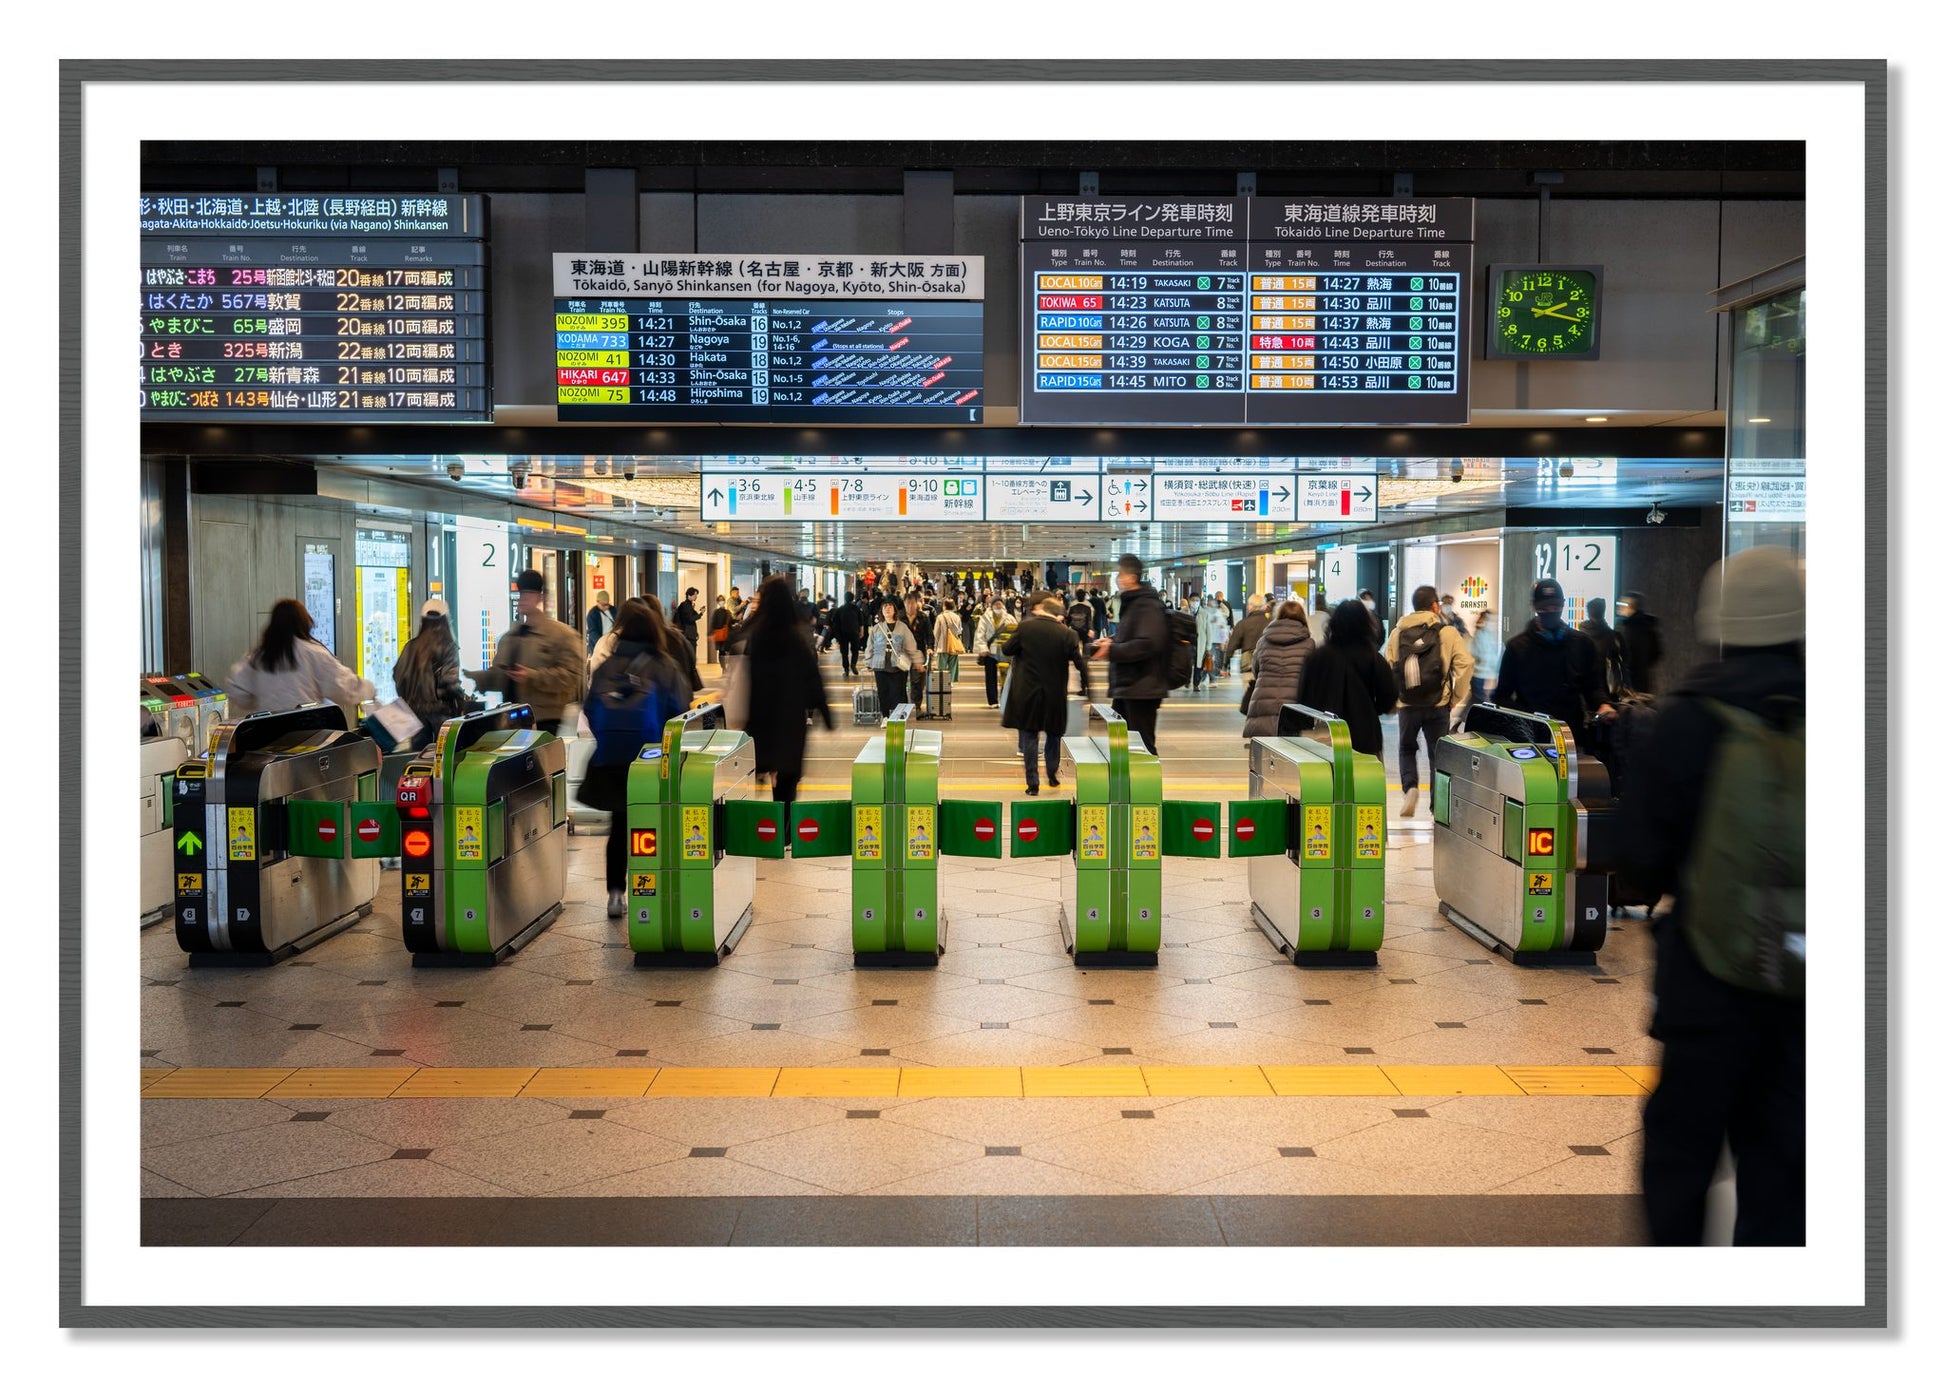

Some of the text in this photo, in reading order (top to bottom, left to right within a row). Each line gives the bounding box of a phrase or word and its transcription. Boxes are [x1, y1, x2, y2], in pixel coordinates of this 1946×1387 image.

[1038, 203, 1233, 222] 上野東京ライン発車時刻
[1284, 204, 1436, 223] 東海道線発車時刻
[331, 220, 348, 232] (via
[350, 220, 392, 232] Nagano)
[394, 220, 448, 230] Shinkansen
[1113, 226, 1138, 237] Line
[1141, 226, 1201, 239] Departure
[1205, 227, 1233, 237] Time
[1326, 227, 1350, 238] Line
[1353, 227, 1413, 240] Departure
[1417, 227, 1445, 238] Time
[232, 270, 266, 285] 25号
[336, 269, 384, 287] 20番線
[386, 270, 453, 286] 17両編成
[1040, 278, 1076, 288] LOCAL
[1110, 277, 1147, 289] 14:19
[1218, 278, 1225, 289] 7
[1260, 278, 1392, 290] 普通 14:27 熱海
[1538, 277, 1552, 286] 12
[574, 280, 630, 292] Tōkaidō,
[634, 280, 674, 294] Sanyō
[677, 280, 752, 292] Shinkansen
[758, 280, 782, 293] (for
[786, 281, 839, 294] Nagoya,
[1523, 281, 1535, 290] 11
[149, 292, 302, 311] はくたか 567号 敦賀
[1509, 292, 1523, 301] 10
[1570, 291, 1579, 300] 2
[1041, 297, 1226, 309] TOKIWA 65 14:23 KATSUTA 8
[1323, 297, 1391, 310] 14:30 品川
[1501, 308, 1510, 317] 9
[1577, 308, 1585, 317] 3
[150, 317, 302, 335] やまびこ 65号 盛岡
[558, 316, 598, 325] NOZOMI
[601, 318, 626, 329] 395
[638, 318, 673, 330] 14:21
[752, 318, 766, 330] 16
[1040, 316, 1190, 328] RAPID 14:26 KATSUTA
[1323, 317, 1391, 330] 14:37 熱海
[558, 334, 766, 348] KODAMA 733 14:27 Nagoya 19
[1110, 336, 1190, 348] 14:29 KOGA
[1260, 337, 1390, 349] 特急 10両 14:43 品川
[1537, 338, 1547, 348] 6
[151, 342, 302, 360] とき 325号 新潟
[558, 352, 766, 366] NOZOMI 41 14:30 Hakata 18
[1110, 356, 1146, 368] 14:39
[1322, 357, 1402, 369] 14:50 小田原
[151, 367, 320, 384] はやぶさ 27号 新青森
[561, 370, 598, 379] HIKARI
[602, 372, 627, 383] 647
[640, 372, 675, 384] 14:33
[753, 372, 766, 384] 15
[1109, 375, 1186, 387] 14:45 MITO
[1321, 376, 1389, 389] 14:53 品川
[226, 392, 269, 407] 143号
[339, 390, 387, 408] 21番線
[388, 392, 455, 407] 17両編成
[560, 388, 600, 396] NOZOMI
[607, 390, 623, 401] 75
[640, 390, 676, 402] 14:48
[691, 388, 743, 398] Hiroshima
[753, 390, 766, 402] 19
[1308, 480, 1337, 490] 京葉線
[944, 499, 973, 509] 新幹線
[483, 543, 495, 566] 2
[1331, 560, 1341, 576] 4
[1210, 571, 1217, 582] 6
[1460, 600, 1487, 609] GRANSTA
[400, 792, 416, 801] QR
[633, 832, 655, 854] IC
[1531, 832, 1552, 853] IC
